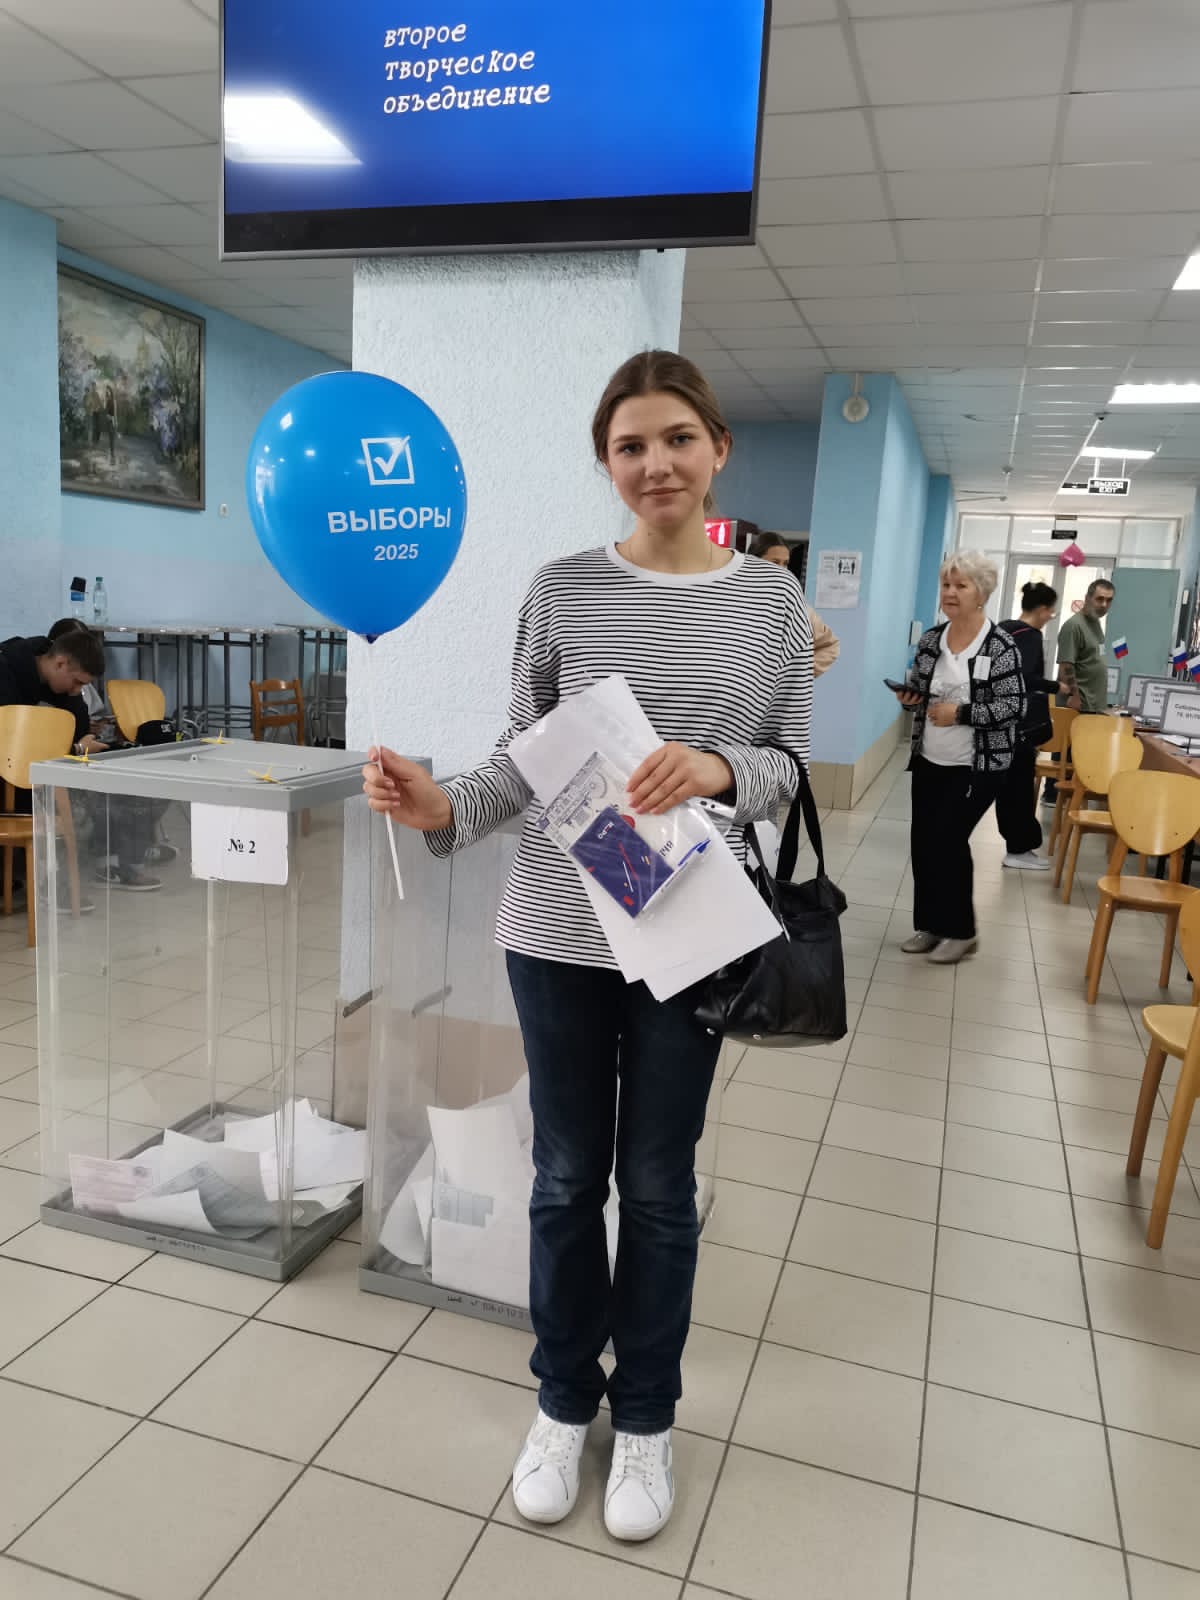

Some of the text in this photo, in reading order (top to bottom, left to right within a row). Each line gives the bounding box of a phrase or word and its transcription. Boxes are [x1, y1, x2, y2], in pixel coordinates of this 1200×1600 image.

[383, 23, 467, 49] второе
[383, 84, 551, 114] объединение
[327, 507, 451, 534] ВЫБОРЫ
[374, 544, 419, 561] 2025
[227, 838, 256, 854] № 2
